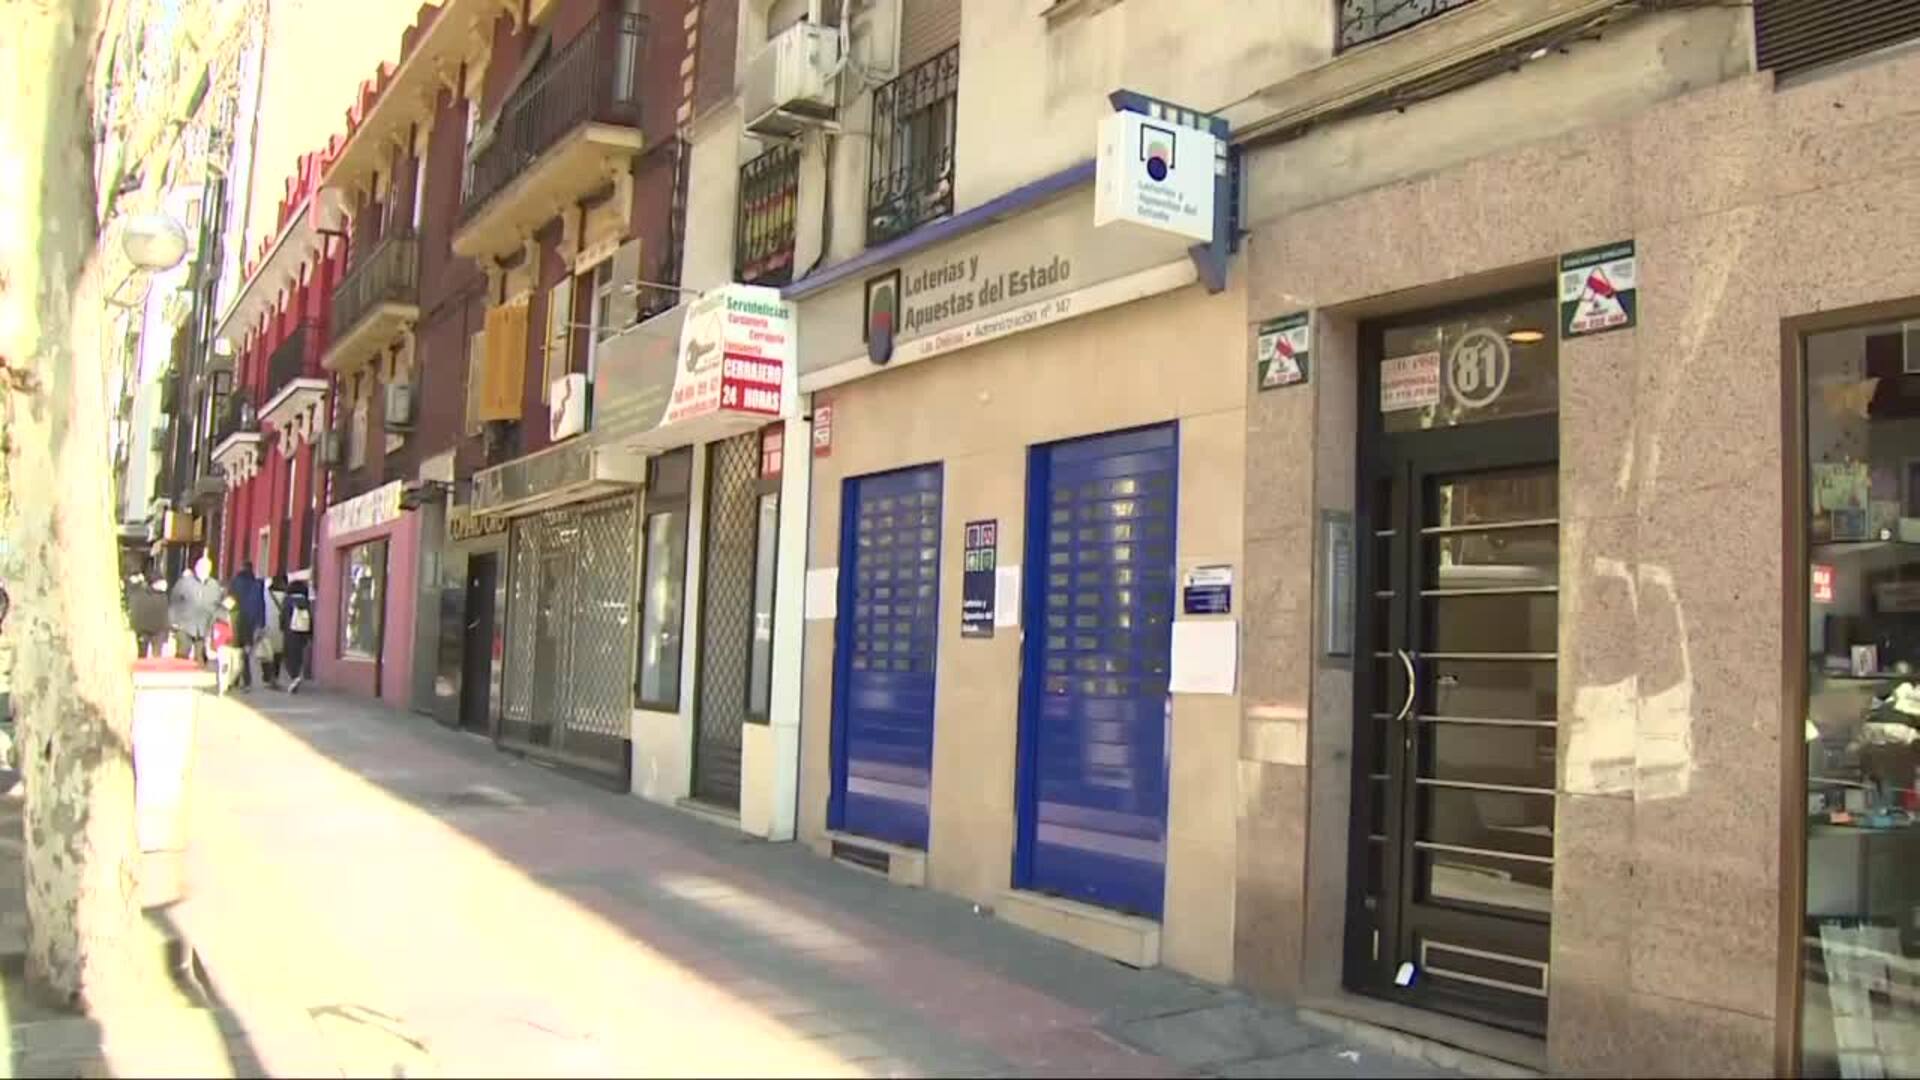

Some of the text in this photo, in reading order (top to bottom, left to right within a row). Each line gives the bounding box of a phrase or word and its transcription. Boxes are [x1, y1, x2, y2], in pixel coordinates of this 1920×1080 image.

[969, 254, 980, 282] y
[904, 254, 1071, 334] Apuestas del Estado
[723, 359, 783, 386] CERRAJERO
[1457, 343, 1498, 392] 81
[722, 384, 737, 405] 24
[743, 387, 780, 413] HORAS
